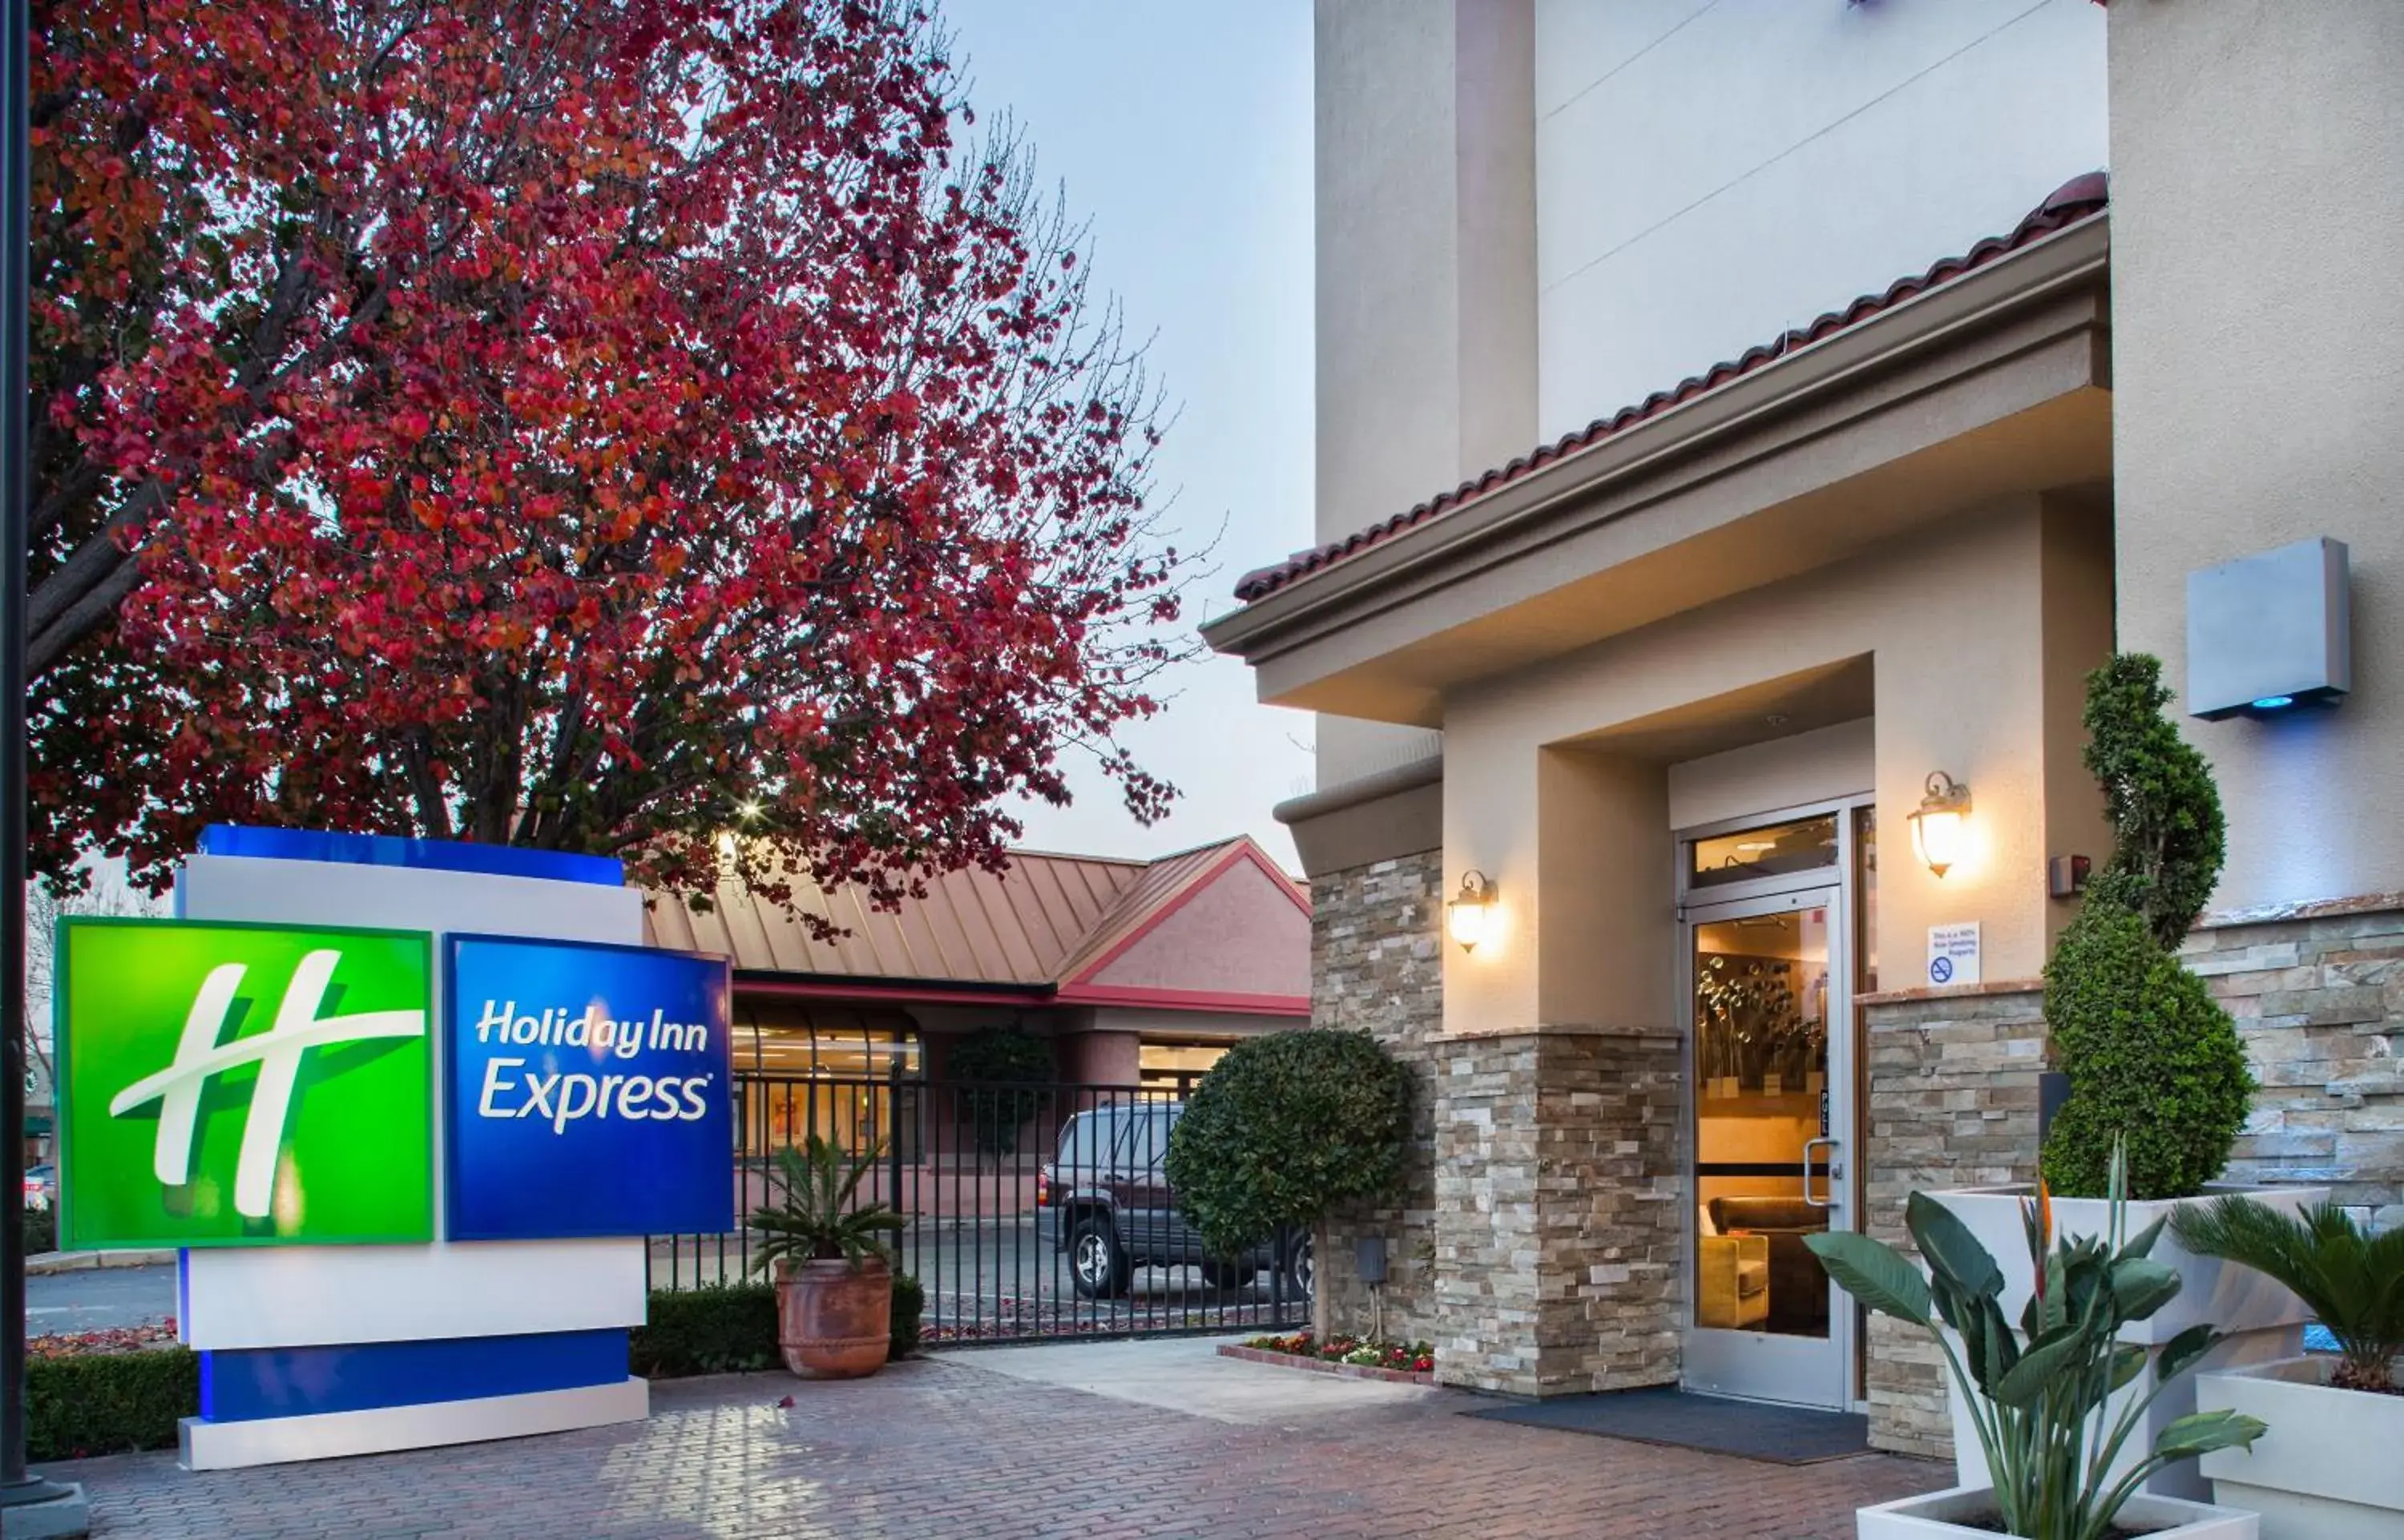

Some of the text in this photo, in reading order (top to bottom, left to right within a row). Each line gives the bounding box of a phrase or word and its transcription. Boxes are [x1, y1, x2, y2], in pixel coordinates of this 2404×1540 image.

[475, 999, 708, 1059] Holiday Inn
[478, 1058, 708, 1135] Express
